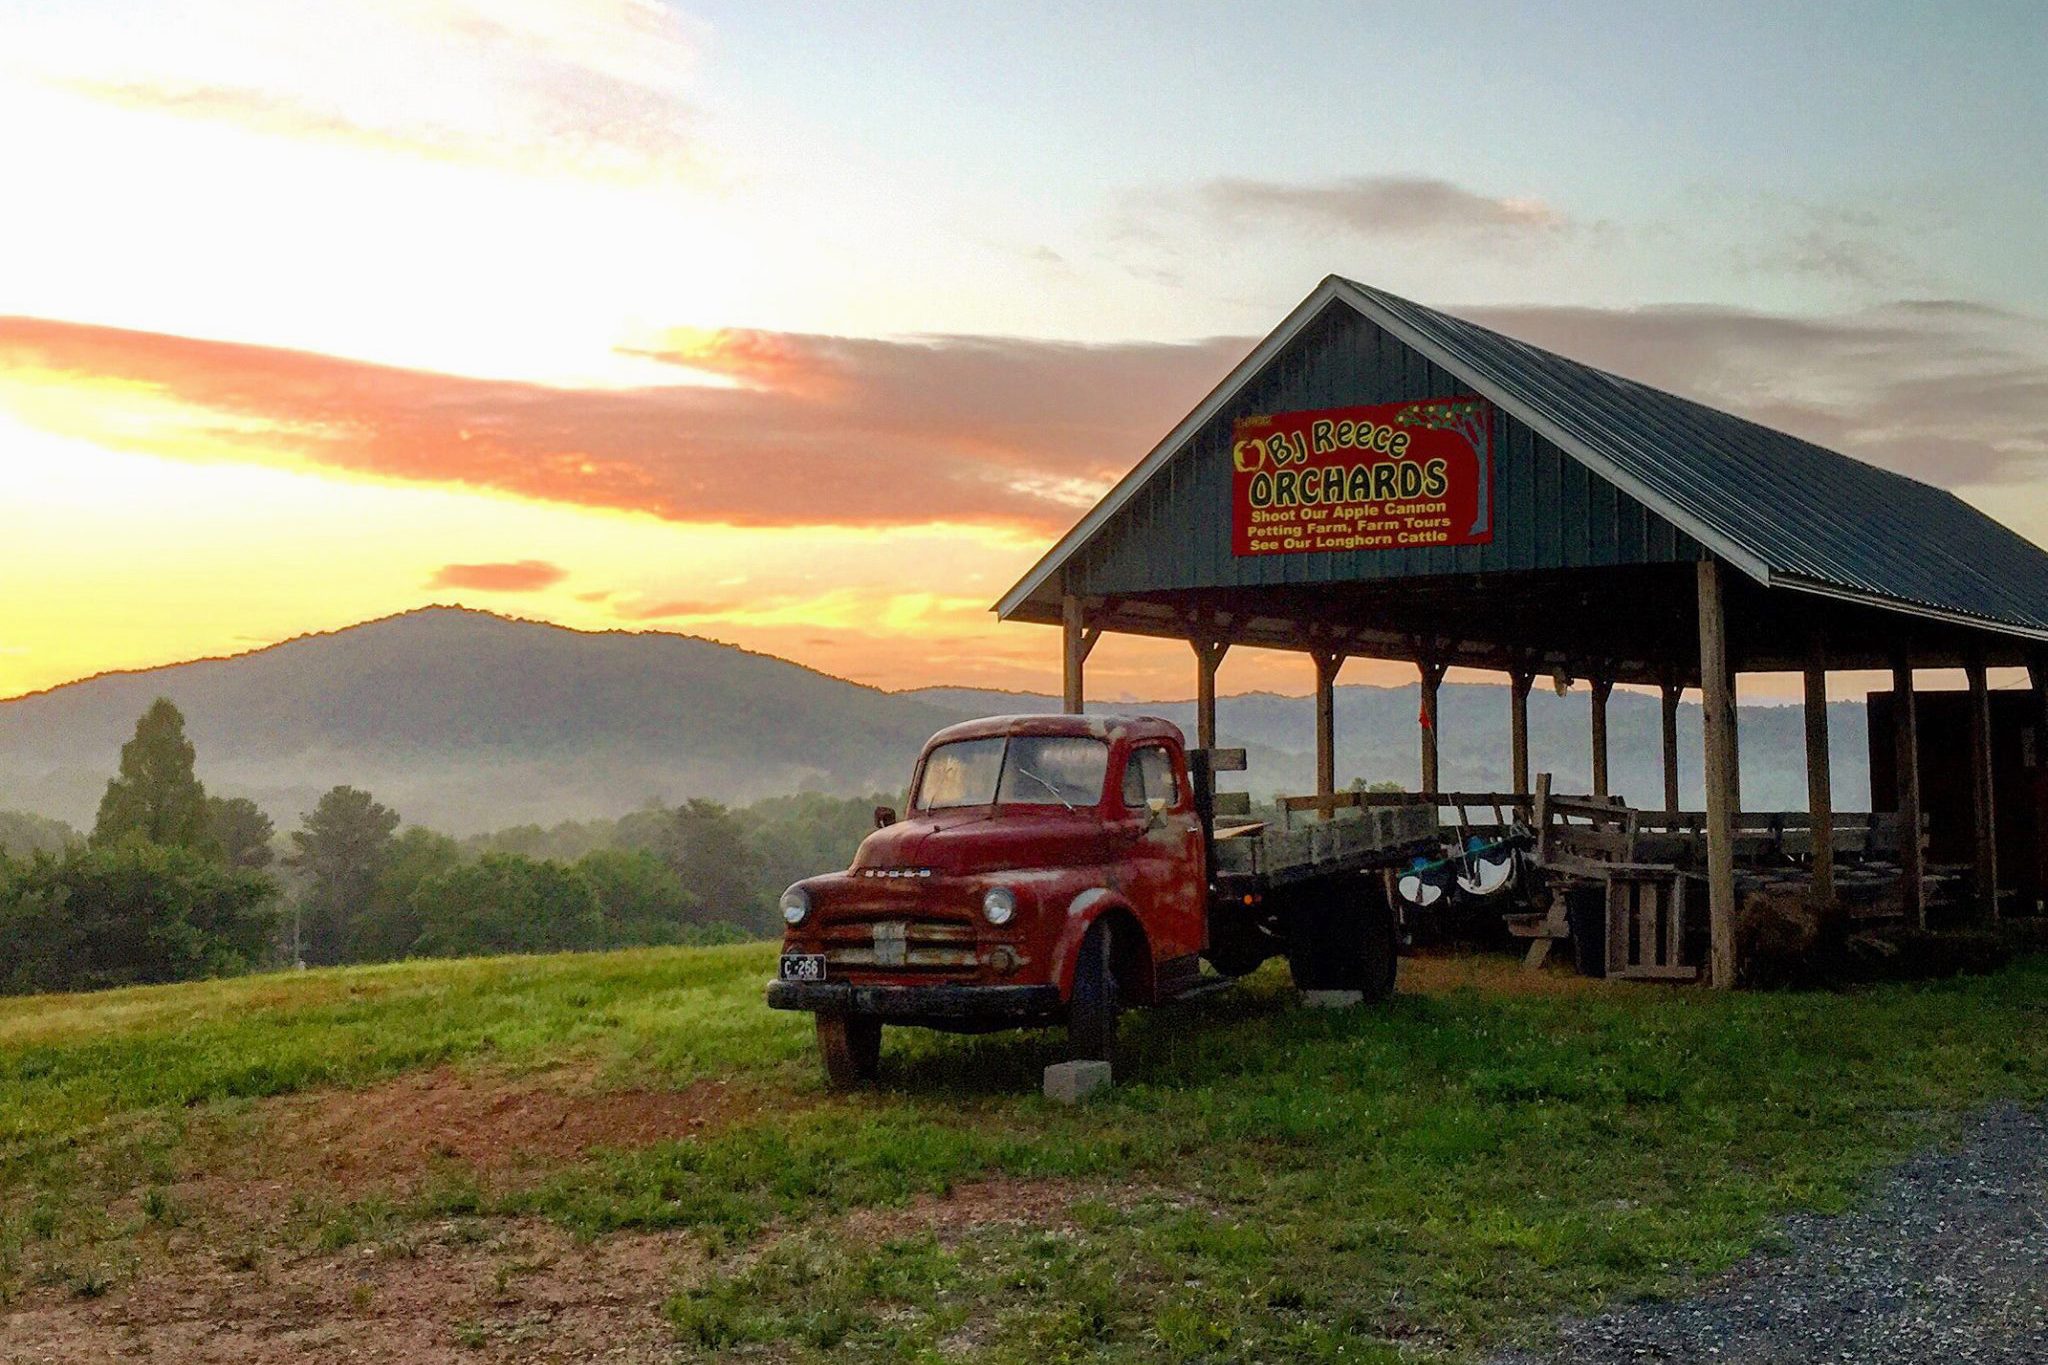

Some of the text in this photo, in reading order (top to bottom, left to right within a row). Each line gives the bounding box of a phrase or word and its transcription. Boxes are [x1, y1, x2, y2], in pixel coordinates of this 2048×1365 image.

[1267, 420, 1410, 467] BJ Reece
[1249, 458, 1448, 508] ORCHARDS
[1252, 502, 1447, 523] Shoot Our Apple Cannon
[1247, 517, 1451, 537] Petting Farm, Farm Tours
[1250, 530, 1448, 551] See Our Longhorn Cattle
